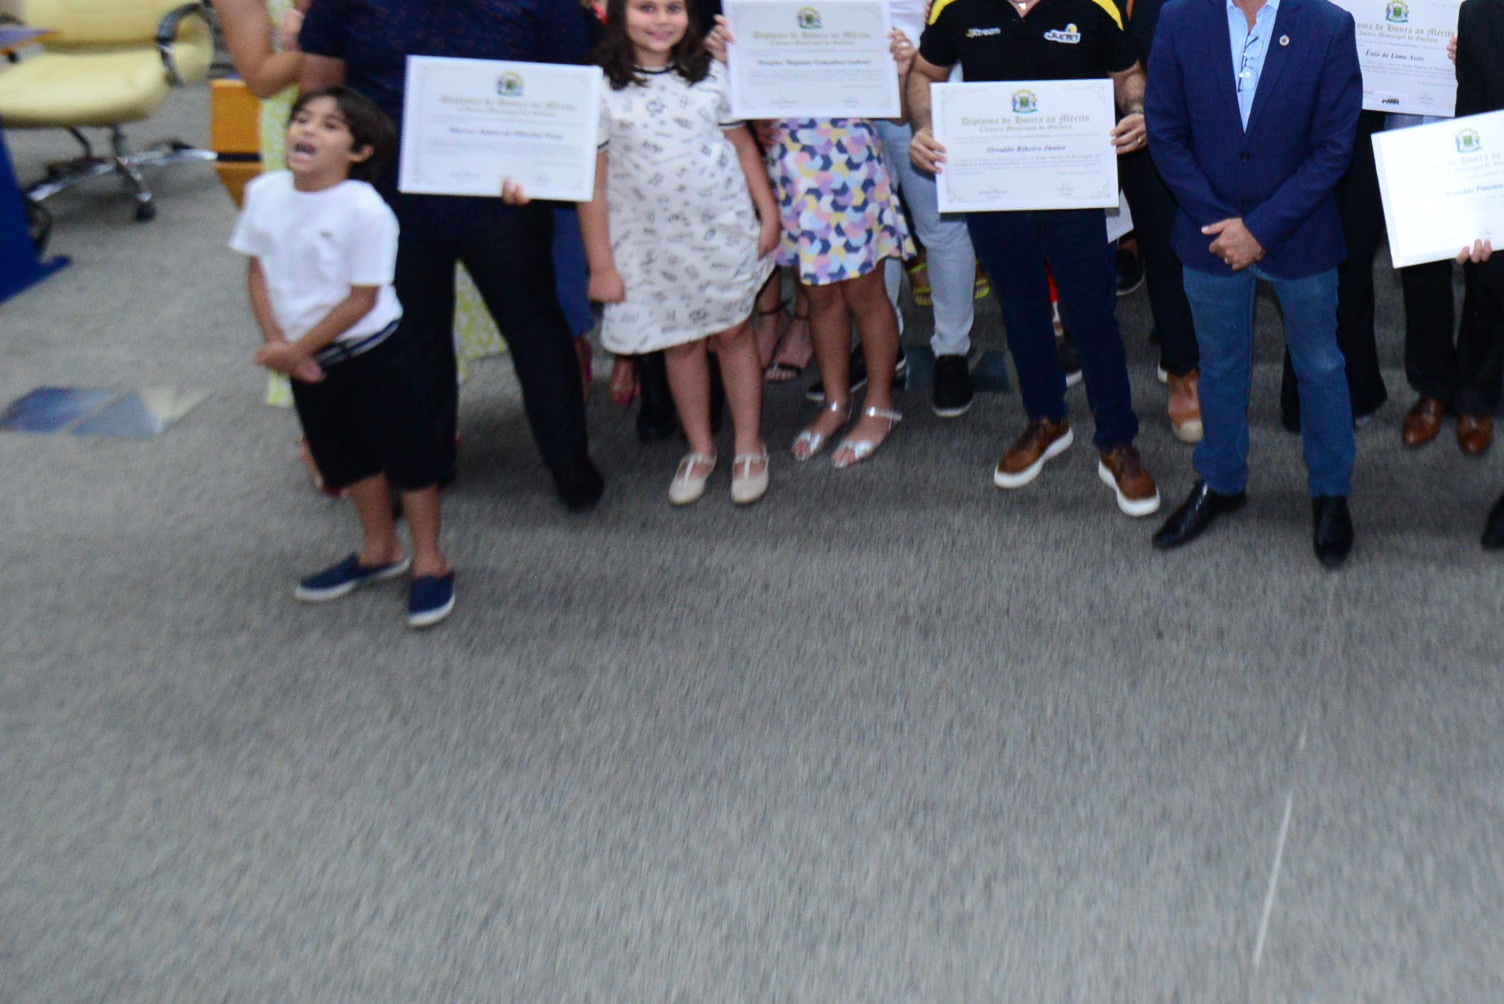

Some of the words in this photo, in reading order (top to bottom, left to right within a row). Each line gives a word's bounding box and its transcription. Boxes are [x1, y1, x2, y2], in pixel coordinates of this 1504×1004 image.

[1387, 24, 1412, 34] Honra
[1427, 28, 1455, 38] Mérito
[1366, 49, 1380, 57] Ênio
[961, 117, 999, 125] Diploma
[1002, 116, 1011, 124] de
[1015, 116, 1043, 124] Honra
[1060, 114, 1090, 124] Mérito
[1448, 159, 1456, 167] de
[1461, 153, 1489, 164] Honra
[1492, 152, 1501, 160] ao
[1476, 183, 1504, 192] Pimenta
